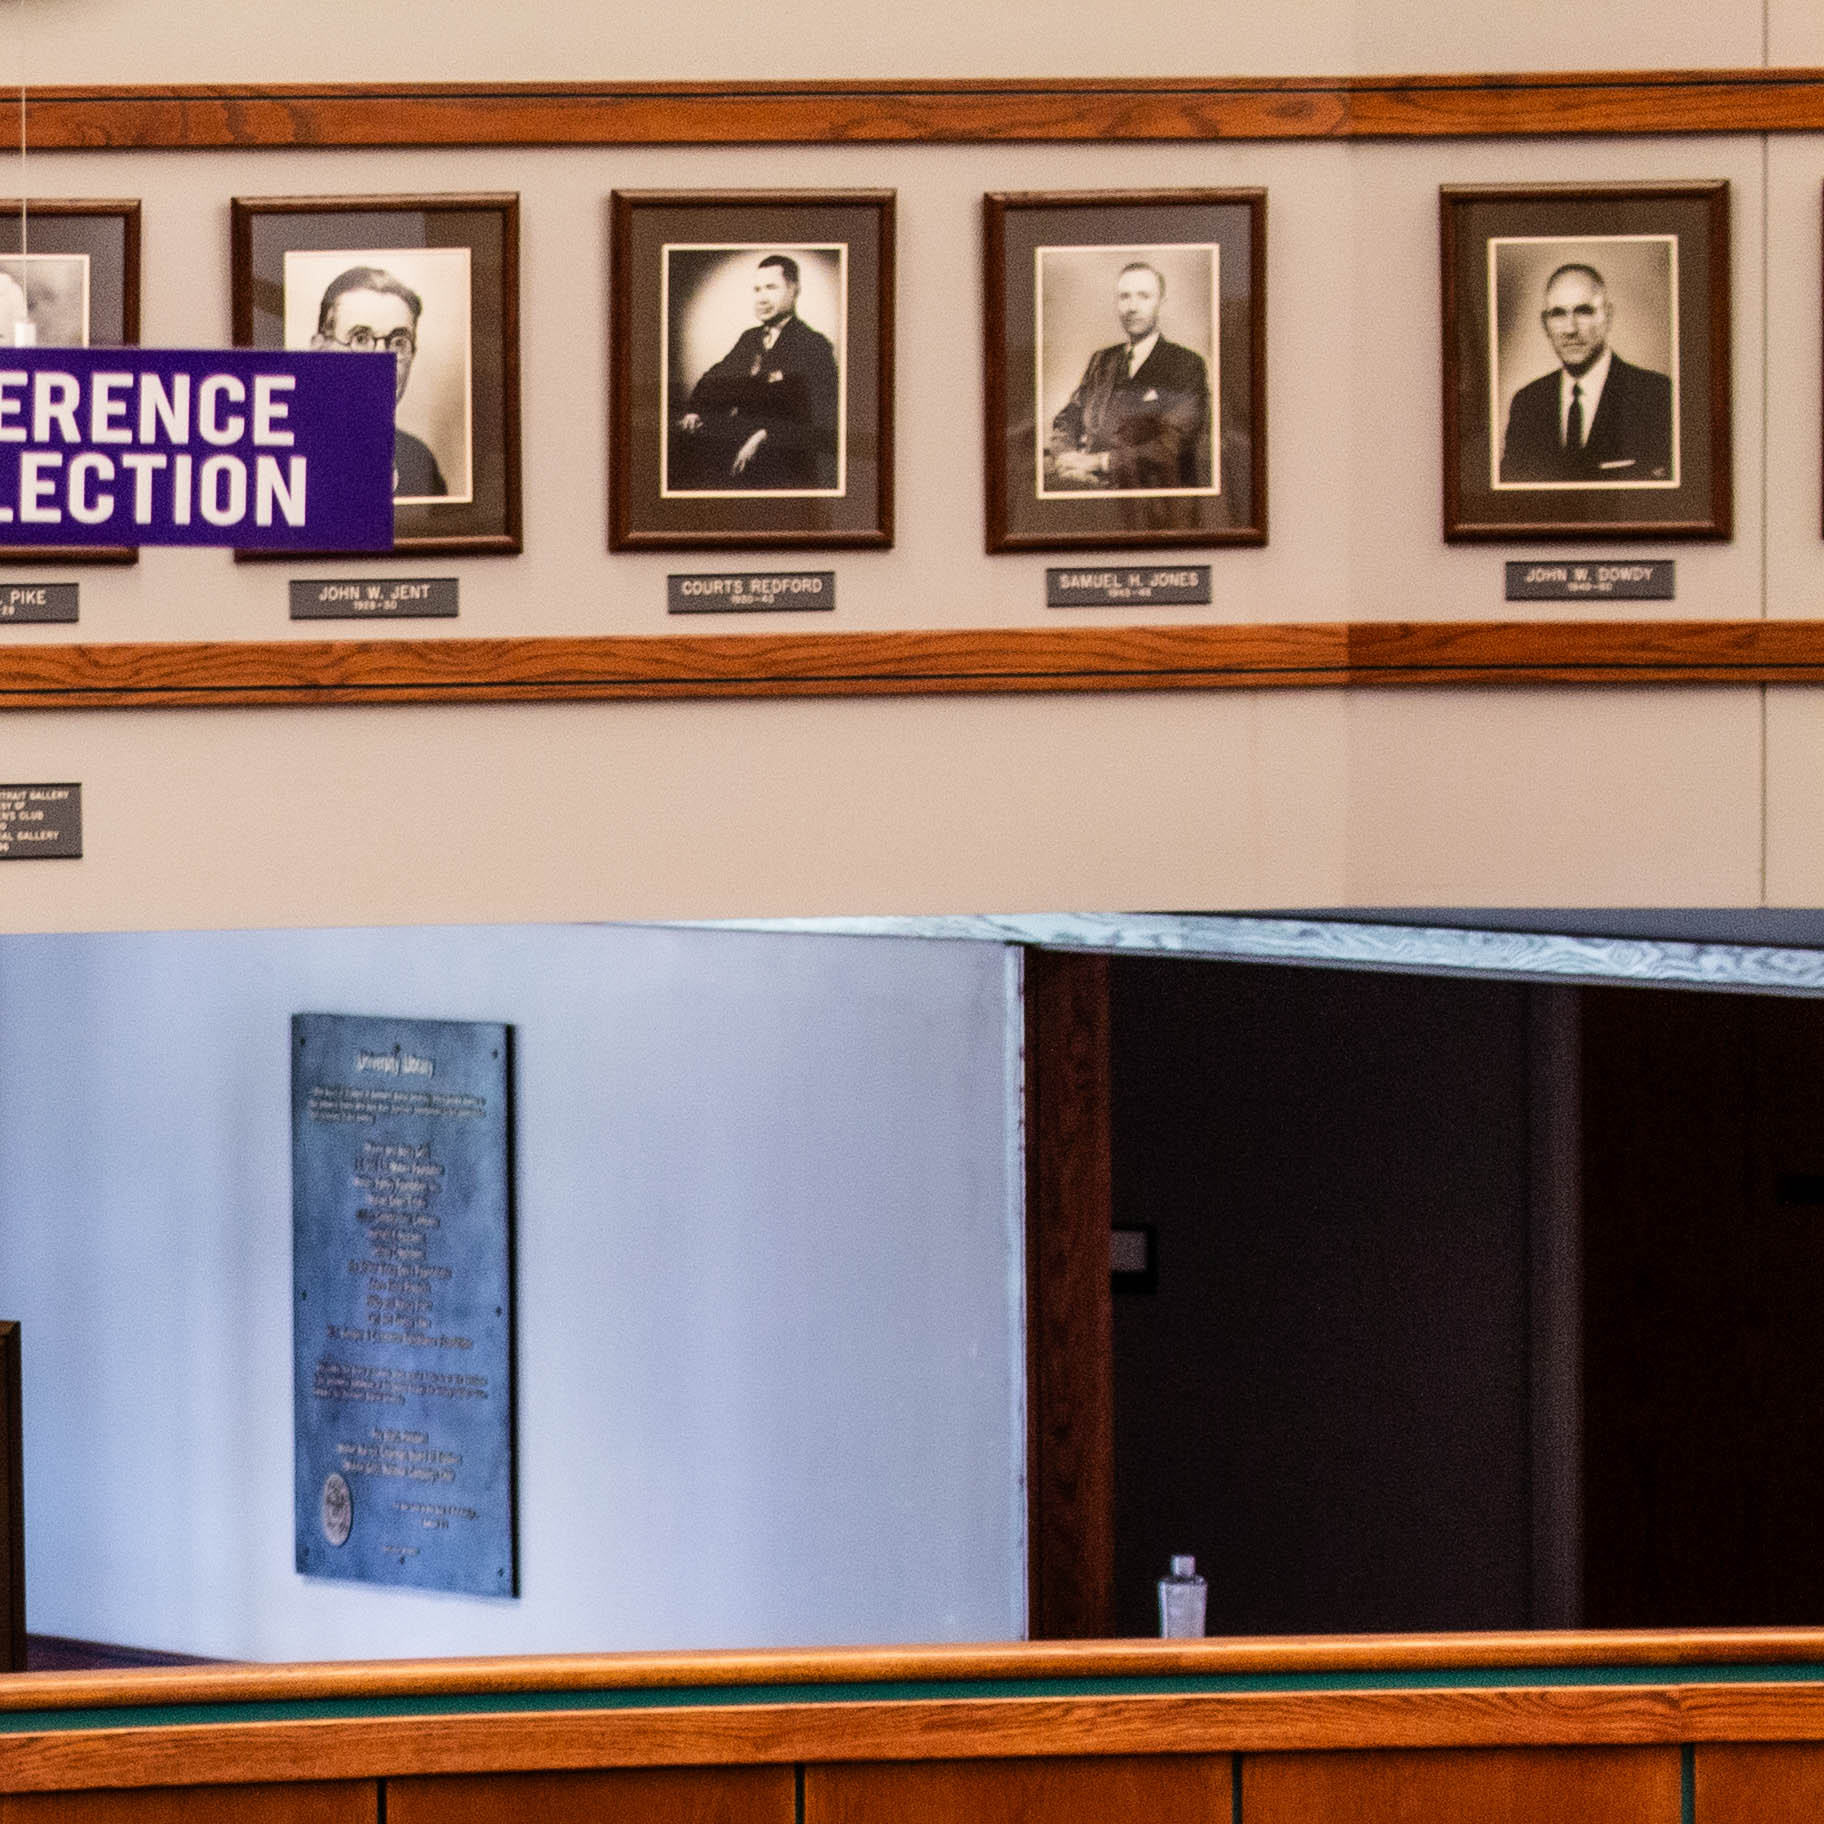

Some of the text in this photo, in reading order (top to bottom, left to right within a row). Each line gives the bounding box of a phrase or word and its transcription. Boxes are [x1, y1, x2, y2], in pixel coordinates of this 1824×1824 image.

[1058, 573, 1123, 590] SAMUEL
[1148, 571, 1200, 588] JONES
[1524, 567, 1569, 584] JOHN
[1597, 566, 1655, 583] DOWDY
[317, 585, 362, 602] JOHN
[389, 583, 432, 600] JENT
[681, 577, 824, 597] COURTS REDFORD
[9, 588, 48, 606] PIKE
[29, 789, 70, 801] GALLERY
[17, 830, 60, 842] GALLERY
